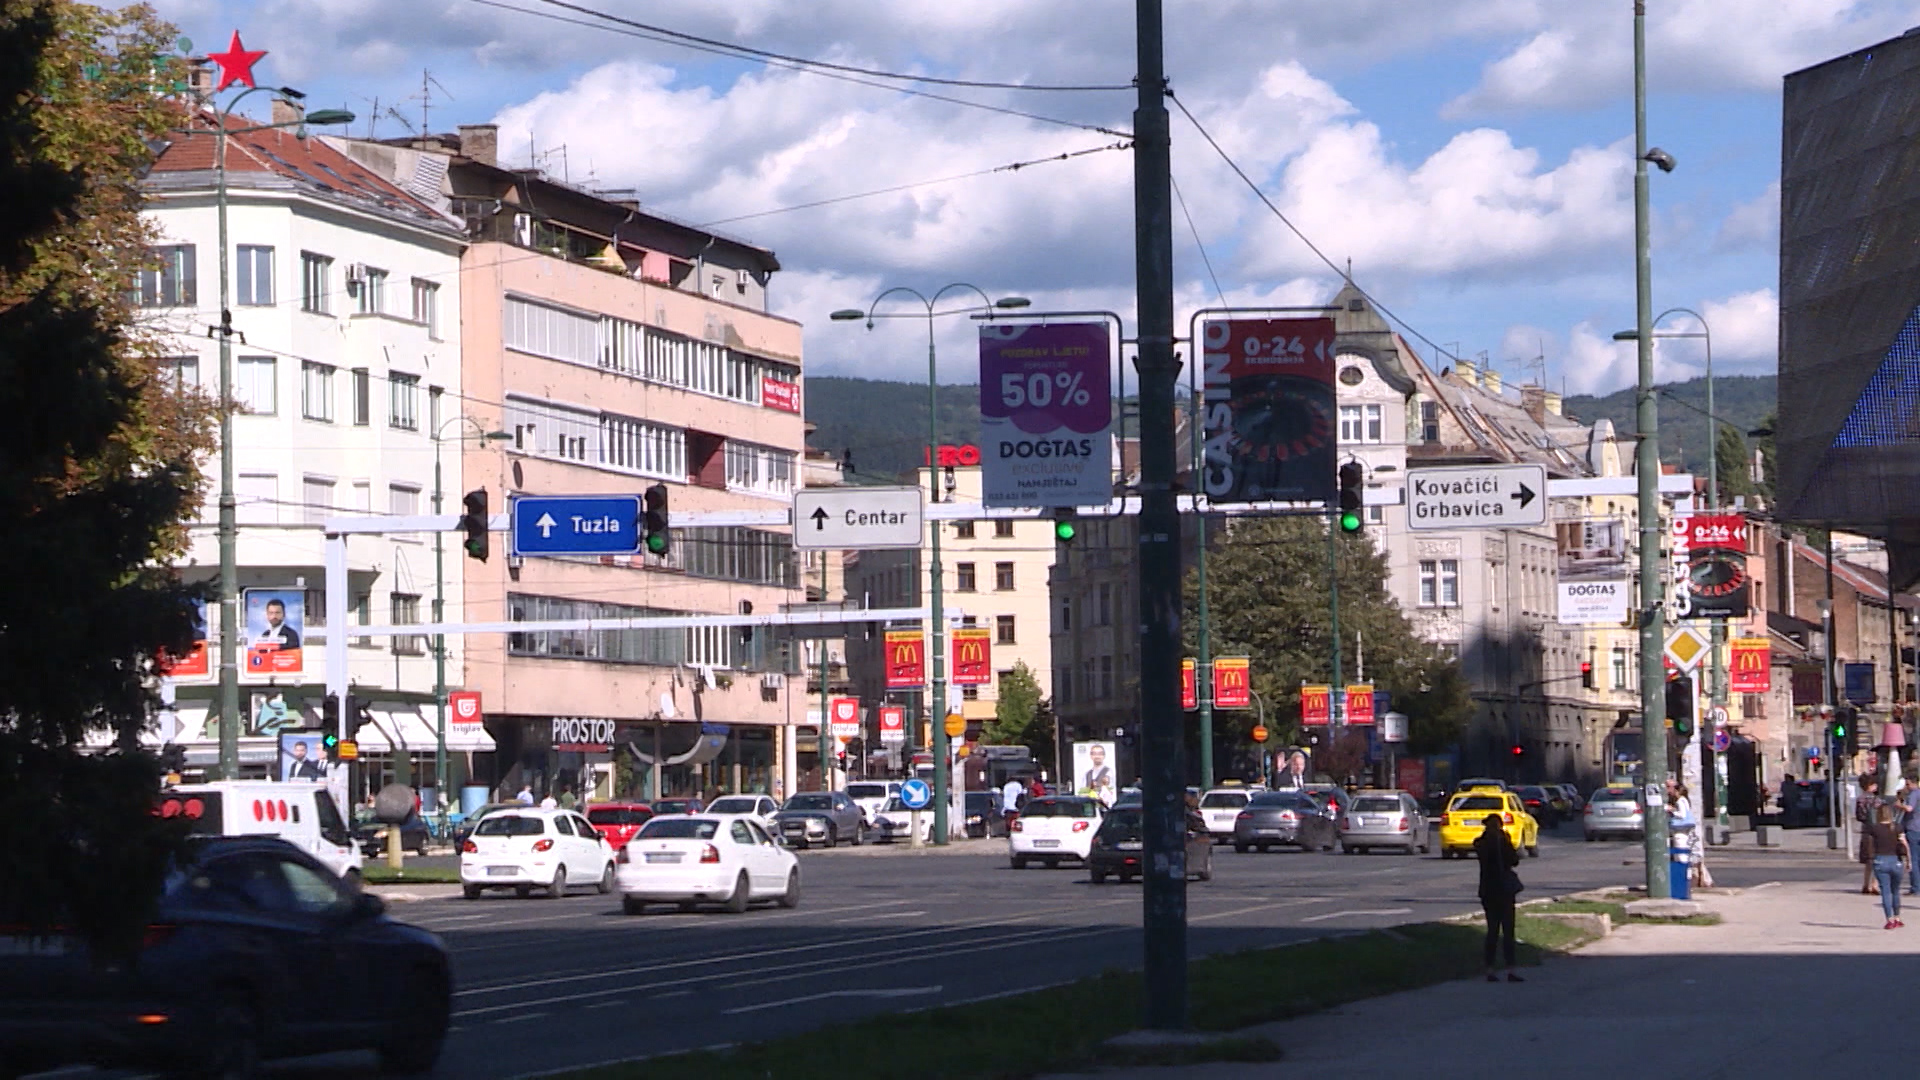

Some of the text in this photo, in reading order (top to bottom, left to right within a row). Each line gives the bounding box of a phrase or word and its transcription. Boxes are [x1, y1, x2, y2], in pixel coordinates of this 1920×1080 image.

[1243, 336, 1305, 357] 0-24
[1001, 371, 1090, 407] 50%
[1204, 321, 1233, 496] CASINO
[1415, 476, 1498, 496] Kovačići
[845, 509, 907, 526] Centar
[1416, 500, 1503, 518] Grbavica
[570, 515, 620, 533] Tuzla
[1674, 518, 1691, 616] CASINO
[552, 717, 615, 744] PROSTOR
